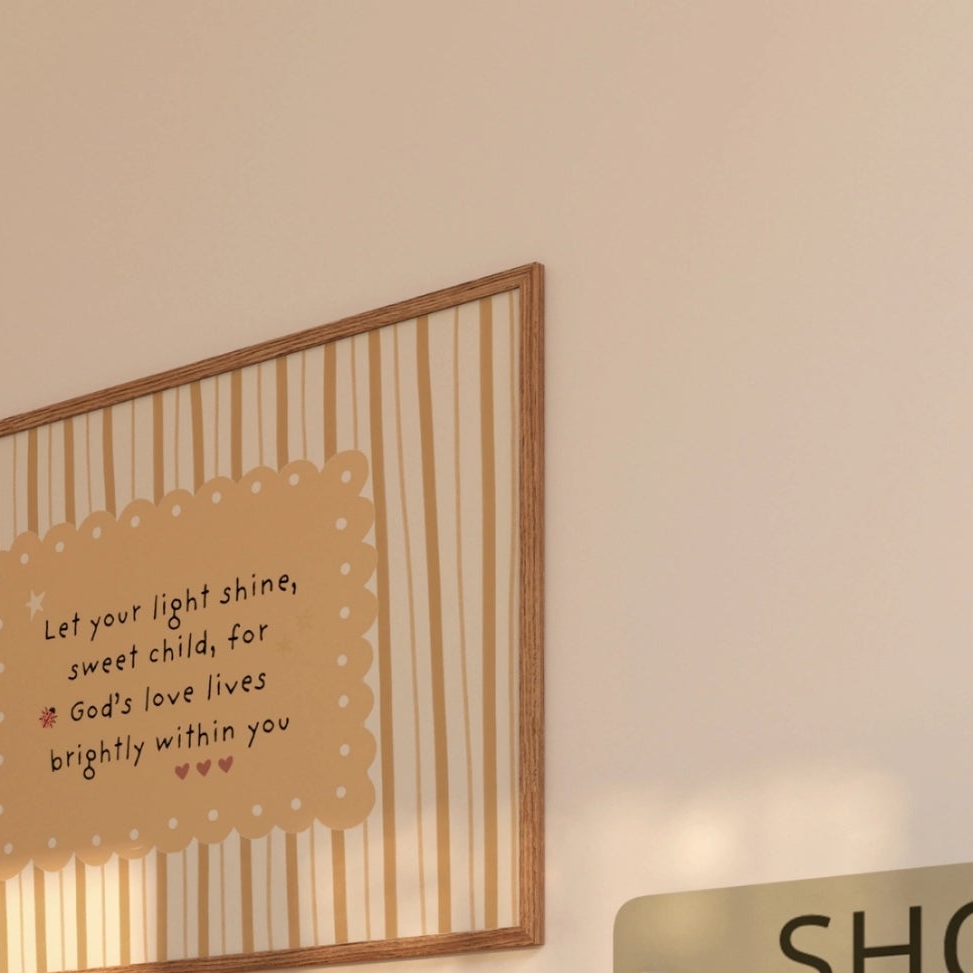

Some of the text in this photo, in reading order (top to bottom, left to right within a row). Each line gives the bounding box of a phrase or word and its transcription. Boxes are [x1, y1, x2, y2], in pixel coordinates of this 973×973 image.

[45, 573, 298, 642] Let your light shine,
[68, 623, 269, 680] sweet child, for
[70, 672, 266, 722] God's love lives
[50, 716, 290, 780] brightly within you
